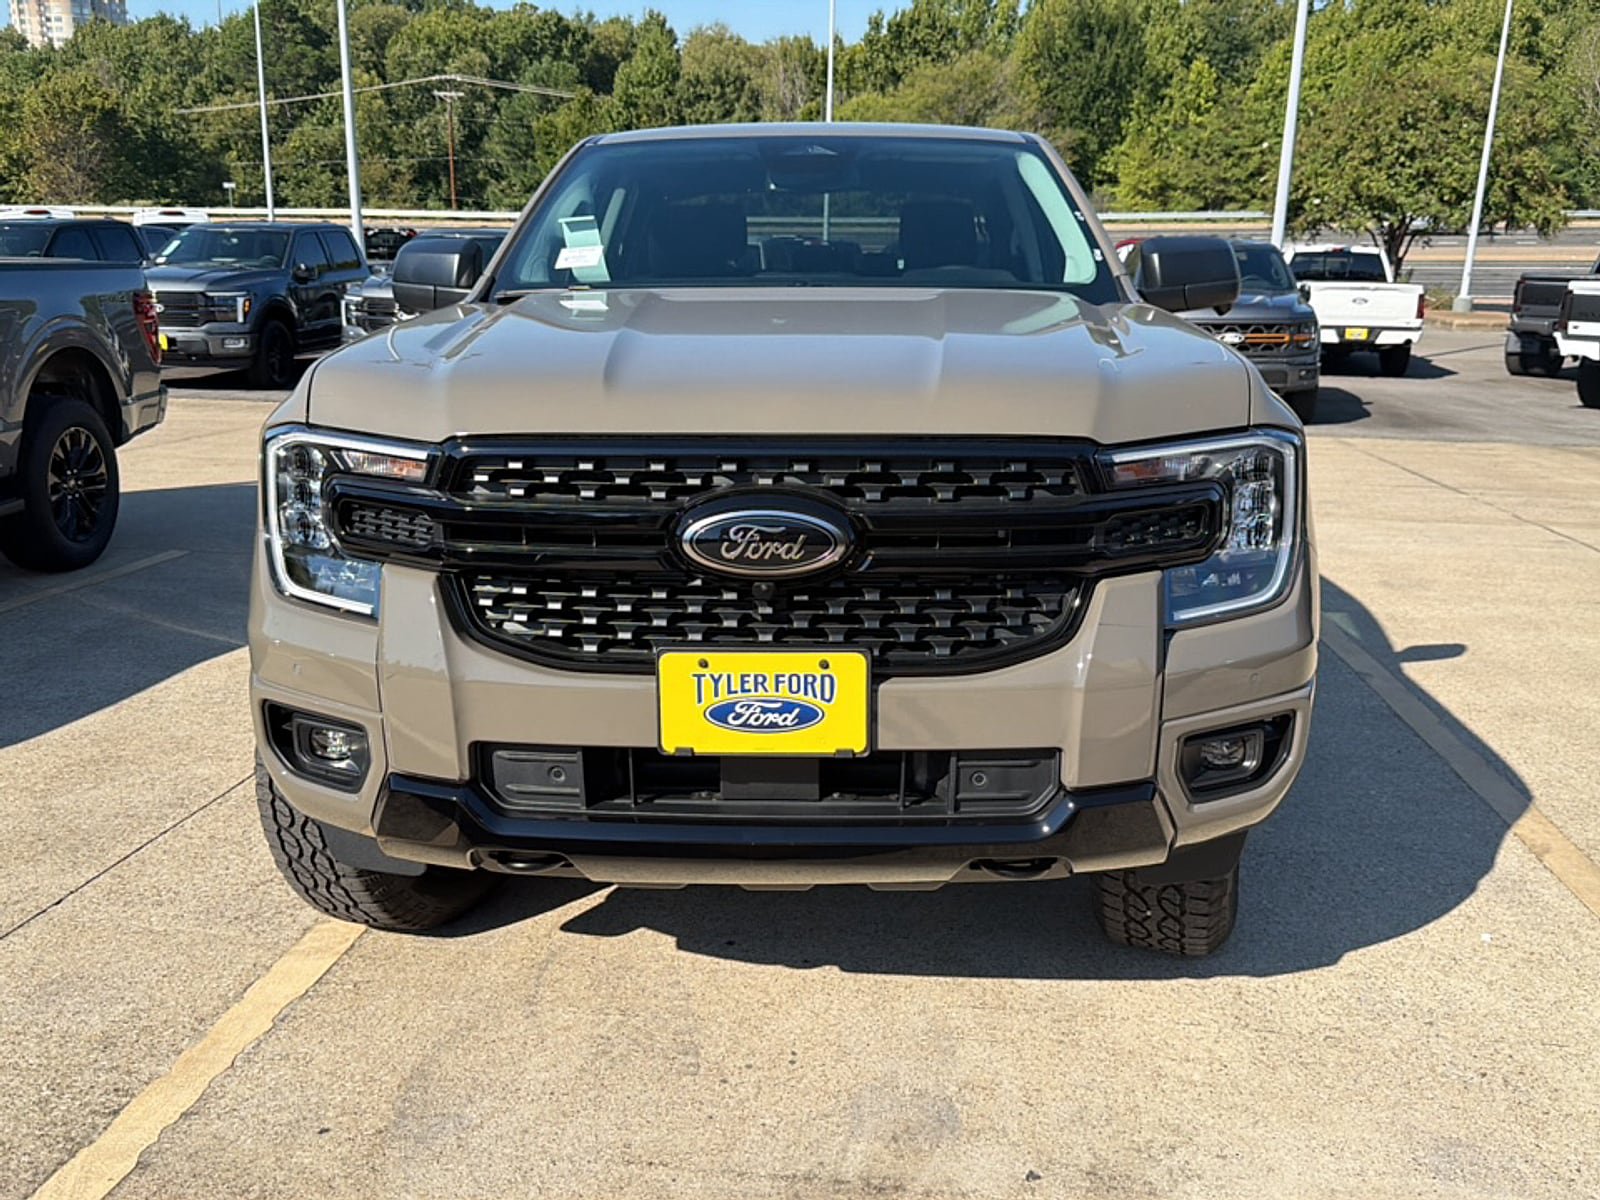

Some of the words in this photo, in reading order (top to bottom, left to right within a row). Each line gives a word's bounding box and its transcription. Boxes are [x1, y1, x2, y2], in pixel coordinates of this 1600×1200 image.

[720, 524, 805, 560] Ford
[692, 673, 769, 704] TYLER
[774, 673, 836, 704] FORD
[727, 701, 799, 726] Ford
